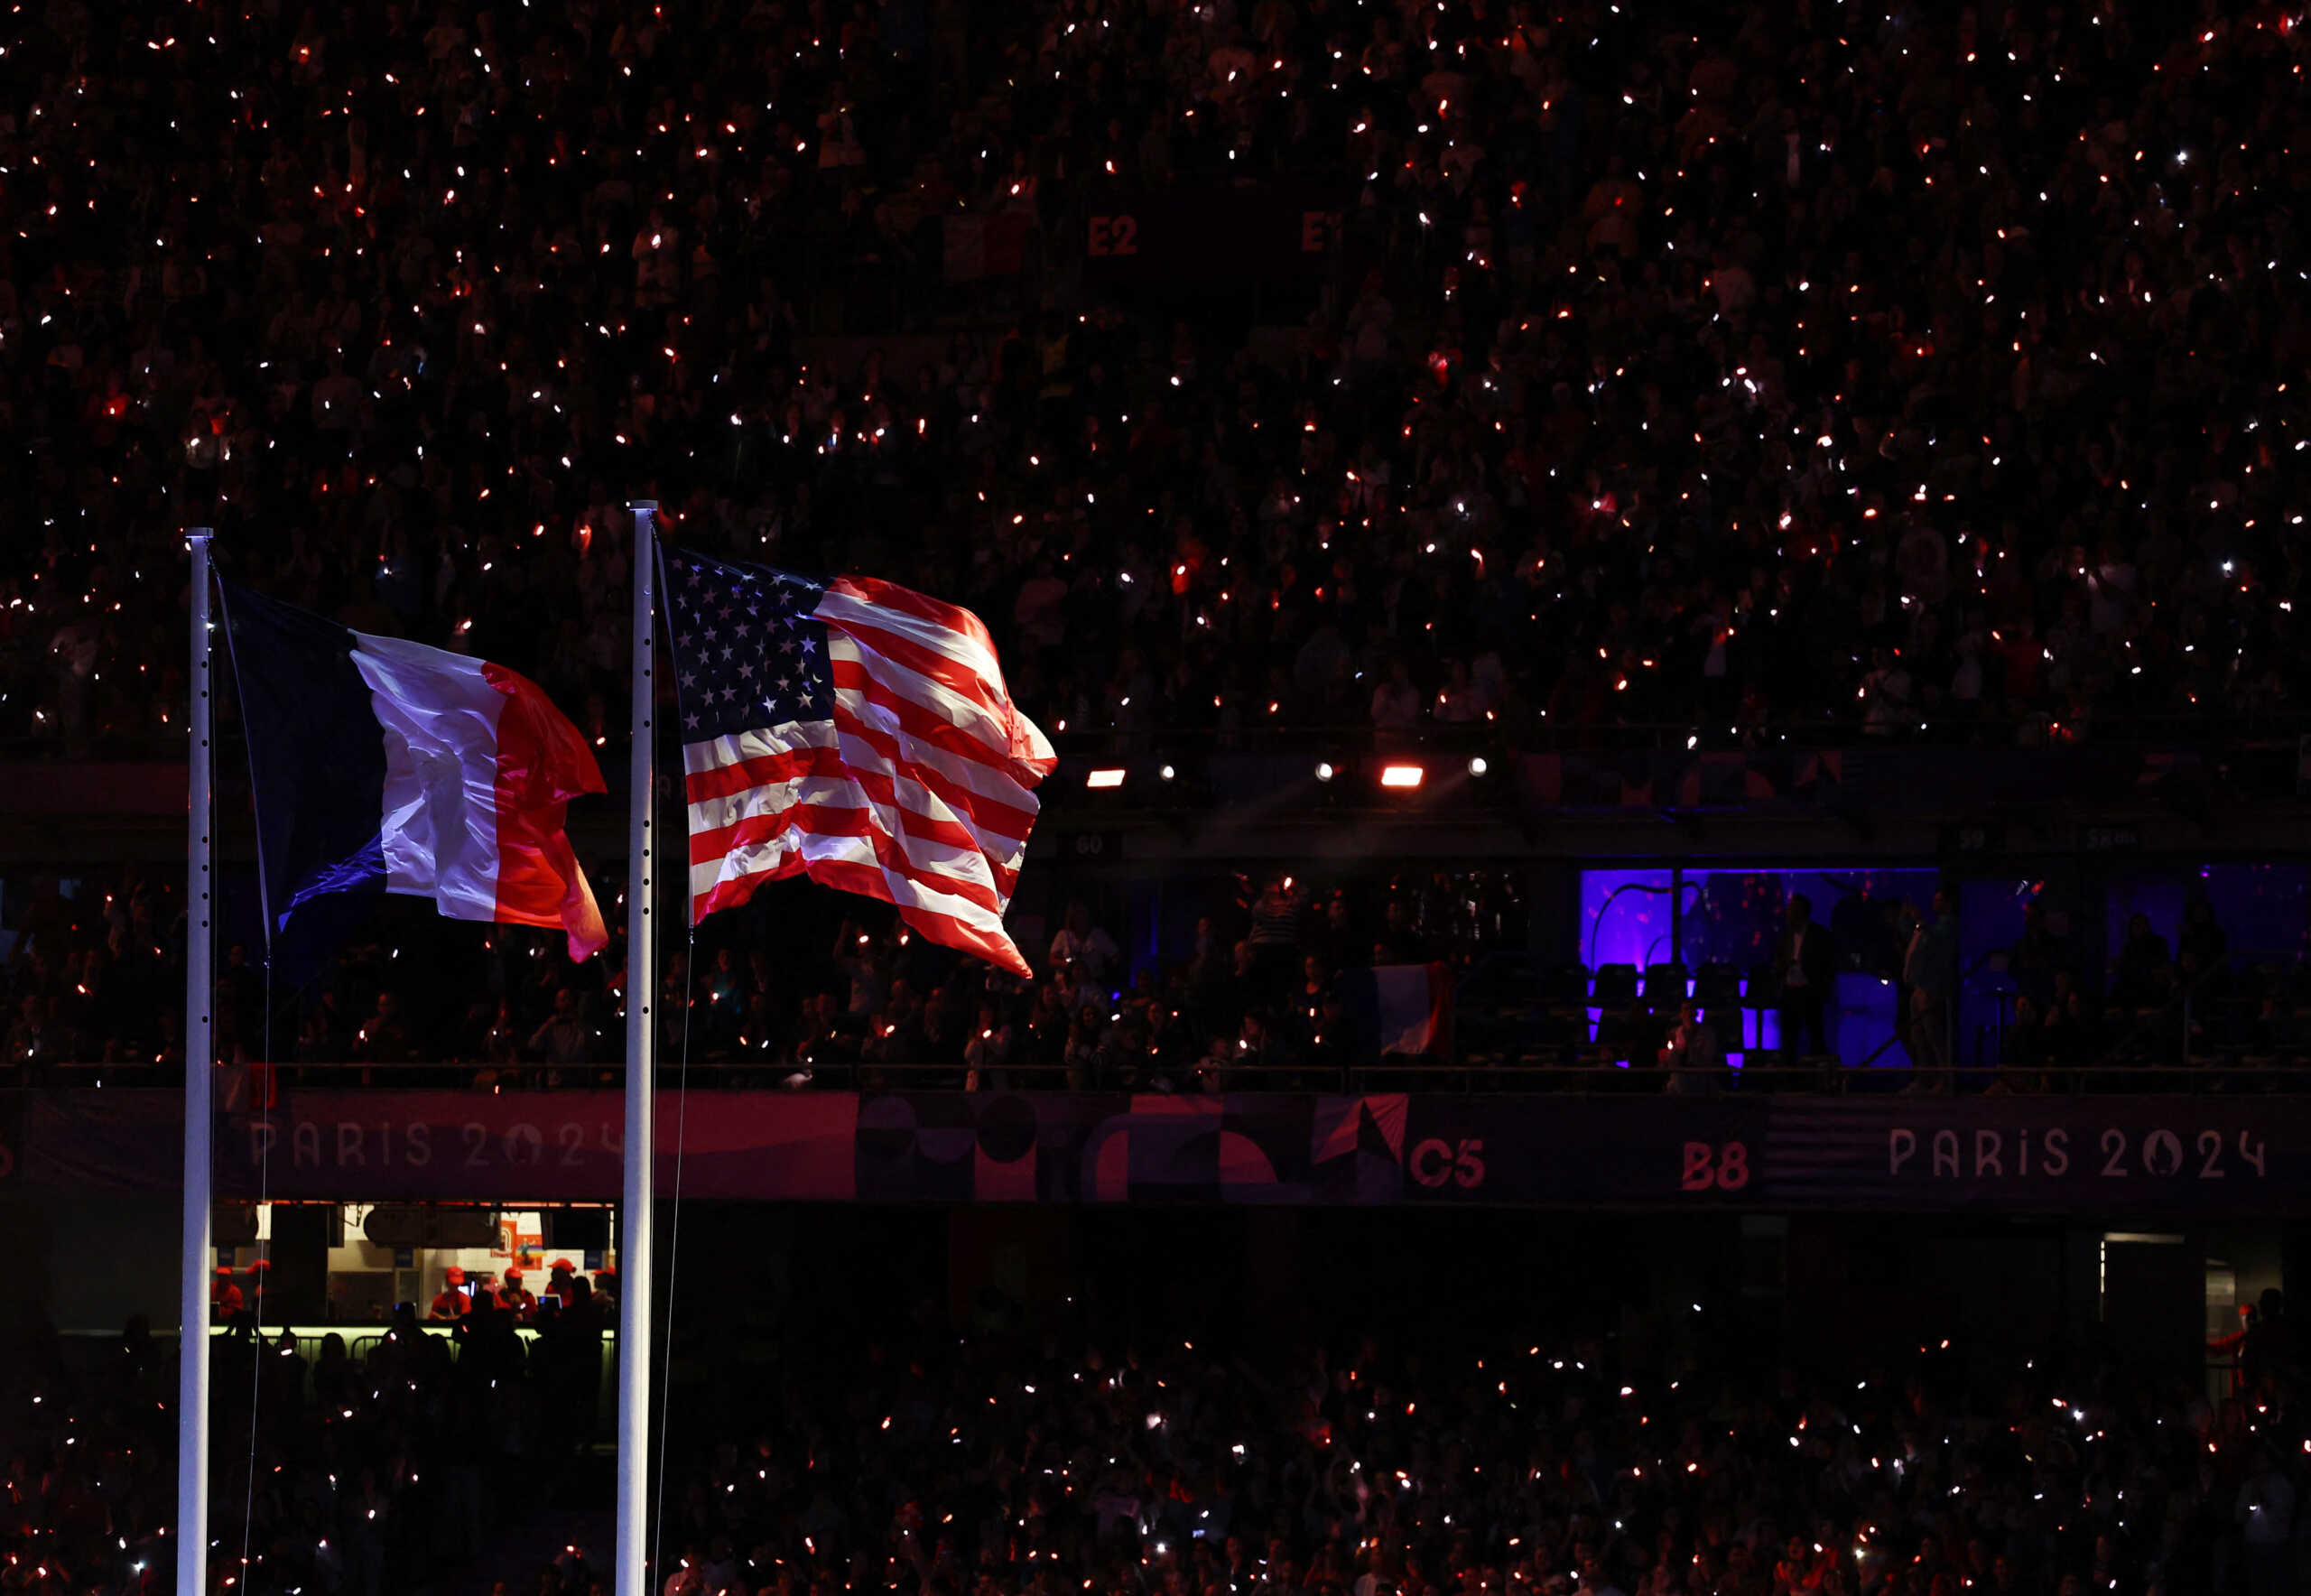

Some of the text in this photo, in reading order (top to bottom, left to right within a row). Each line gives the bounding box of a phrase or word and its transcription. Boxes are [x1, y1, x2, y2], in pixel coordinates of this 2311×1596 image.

[1088, 215, 1137, 255] E2
[461, 1121, 624, 1167] 2024
[1410, 1137, 1485, 1188] C5
[1682, 1140, 1749, 1191] B8
[2100, 1127, 2264, 1178] 2024
